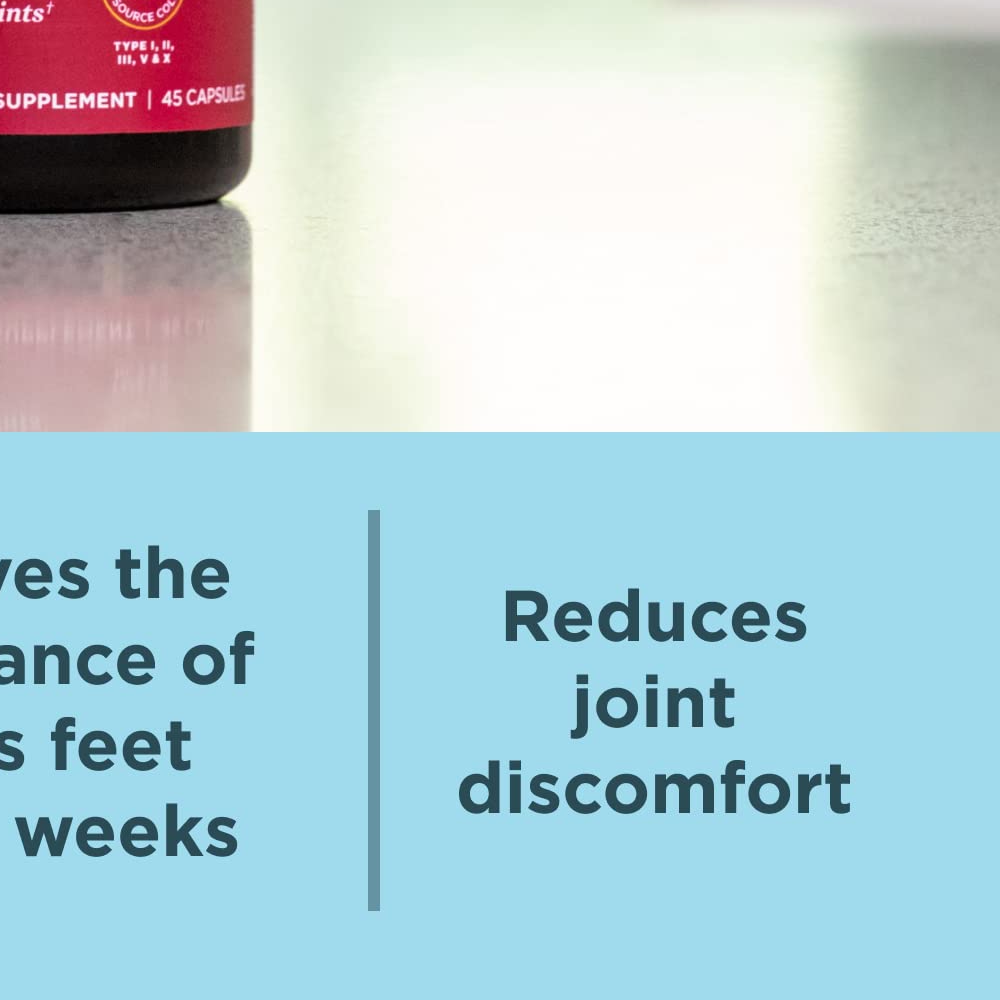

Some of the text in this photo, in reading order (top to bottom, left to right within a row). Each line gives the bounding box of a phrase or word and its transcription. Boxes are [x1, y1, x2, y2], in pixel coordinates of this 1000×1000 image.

[113, 40, 175, 52] TYPE I, II,
[117, 53, 171, 66] III, V & X
[161, 89, 183, 107] 45
[186, 83, 246, 106] CAPSULES
